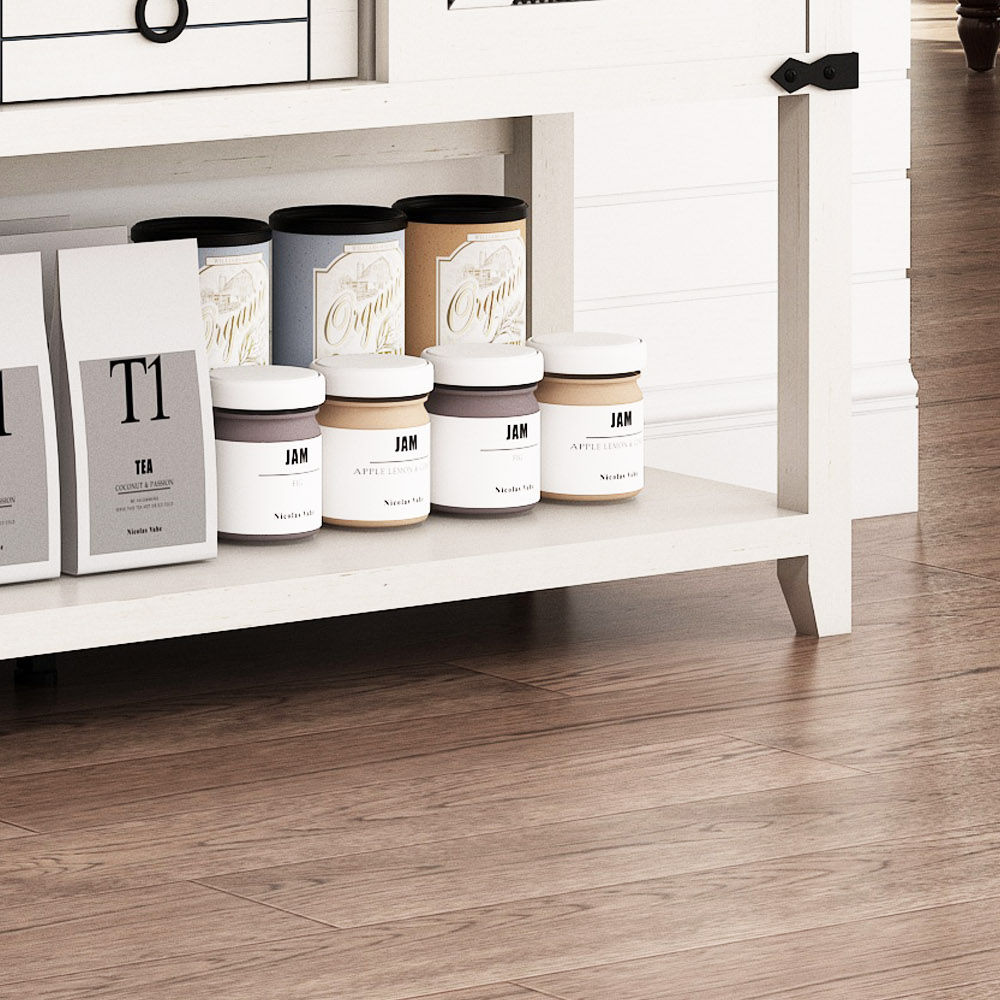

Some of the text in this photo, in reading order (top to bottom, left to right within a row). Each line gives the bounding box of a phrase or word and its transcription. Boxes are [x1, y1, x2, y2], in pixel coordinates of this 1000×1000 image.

[109, 354, 170, 424] T1
[611, 411, 632, 428] JAM
[506, 423, 528, 440] JAM
[395, 434, 418, 452] JAM
[604, 442, 628, 450] LEMON
[286, 448, 308, 465] JAM
[135, 459, 153, 474] TEA
[354, 467, 386, 475] APPLE
[388, 466, 413, 474] LEMON
[115, 482, 143, 492] COCONUT
[150, 479, 174, 488] PASSION
[274, 512, 301, 520] Nicolas
[127, 527, 148, 535] Nicolas
